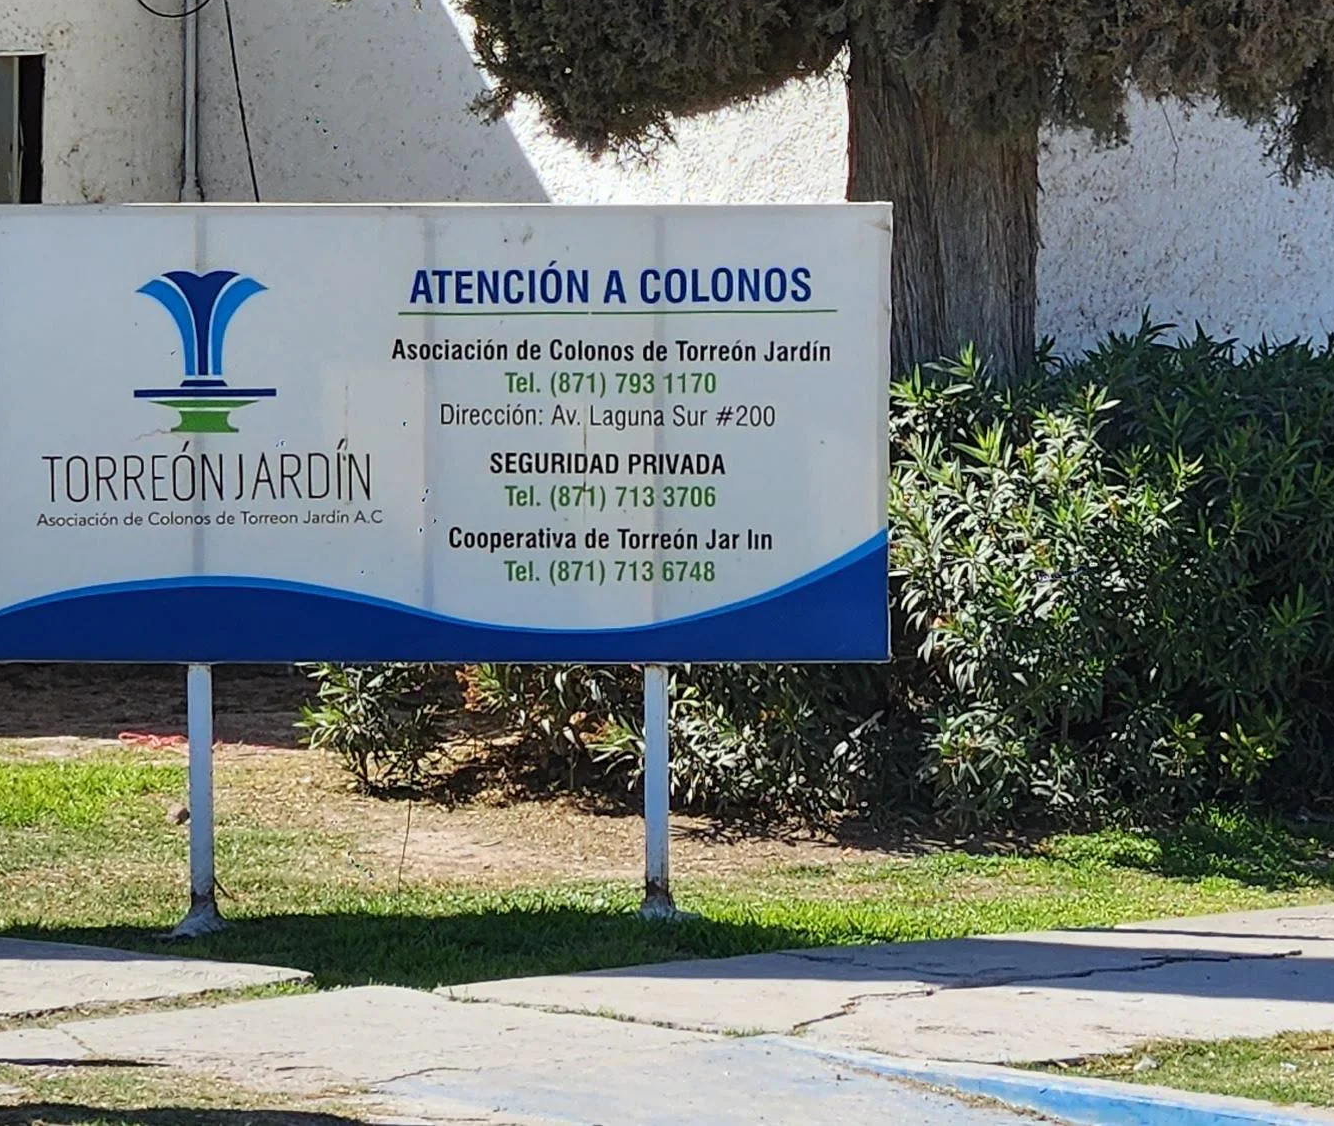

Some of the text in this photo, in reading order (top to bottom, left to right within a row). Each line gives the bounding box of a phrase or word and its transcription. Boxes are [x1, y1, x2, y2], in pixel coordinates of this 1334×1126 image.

[410, 260, 811, 304] ATENCIÓN A COLONOS
[392, 336, 831, 362] Asociación de Colonos de Torreón Jardín
[505, 371, 716, 398] Tel. (871) 793 1170
[441, 402, 775, 430] Dirección: Av. Laguna Sur #200
[41, 438, 371, 502] TORREÓN JARDÍN
[490, 452, 726, 475] SEGURIDAD PRIVADA
[504, 485, 715, 512] Tel. (871) 713 3706
[37, 512, 118, 527] Asociación
[123, 512, 143, 526] de
[148, 511, 211, 526] Colonos
[216, 511, 235, 525] de
[240, 511, 298, 525] Torreon
[449, 527, 576, 553] Cooperativa
[585, 528, 609, 549] de
[617, 526, 697, 550] Torreón
[504, 560, 715, 585] Tel. (871) 713 6748
